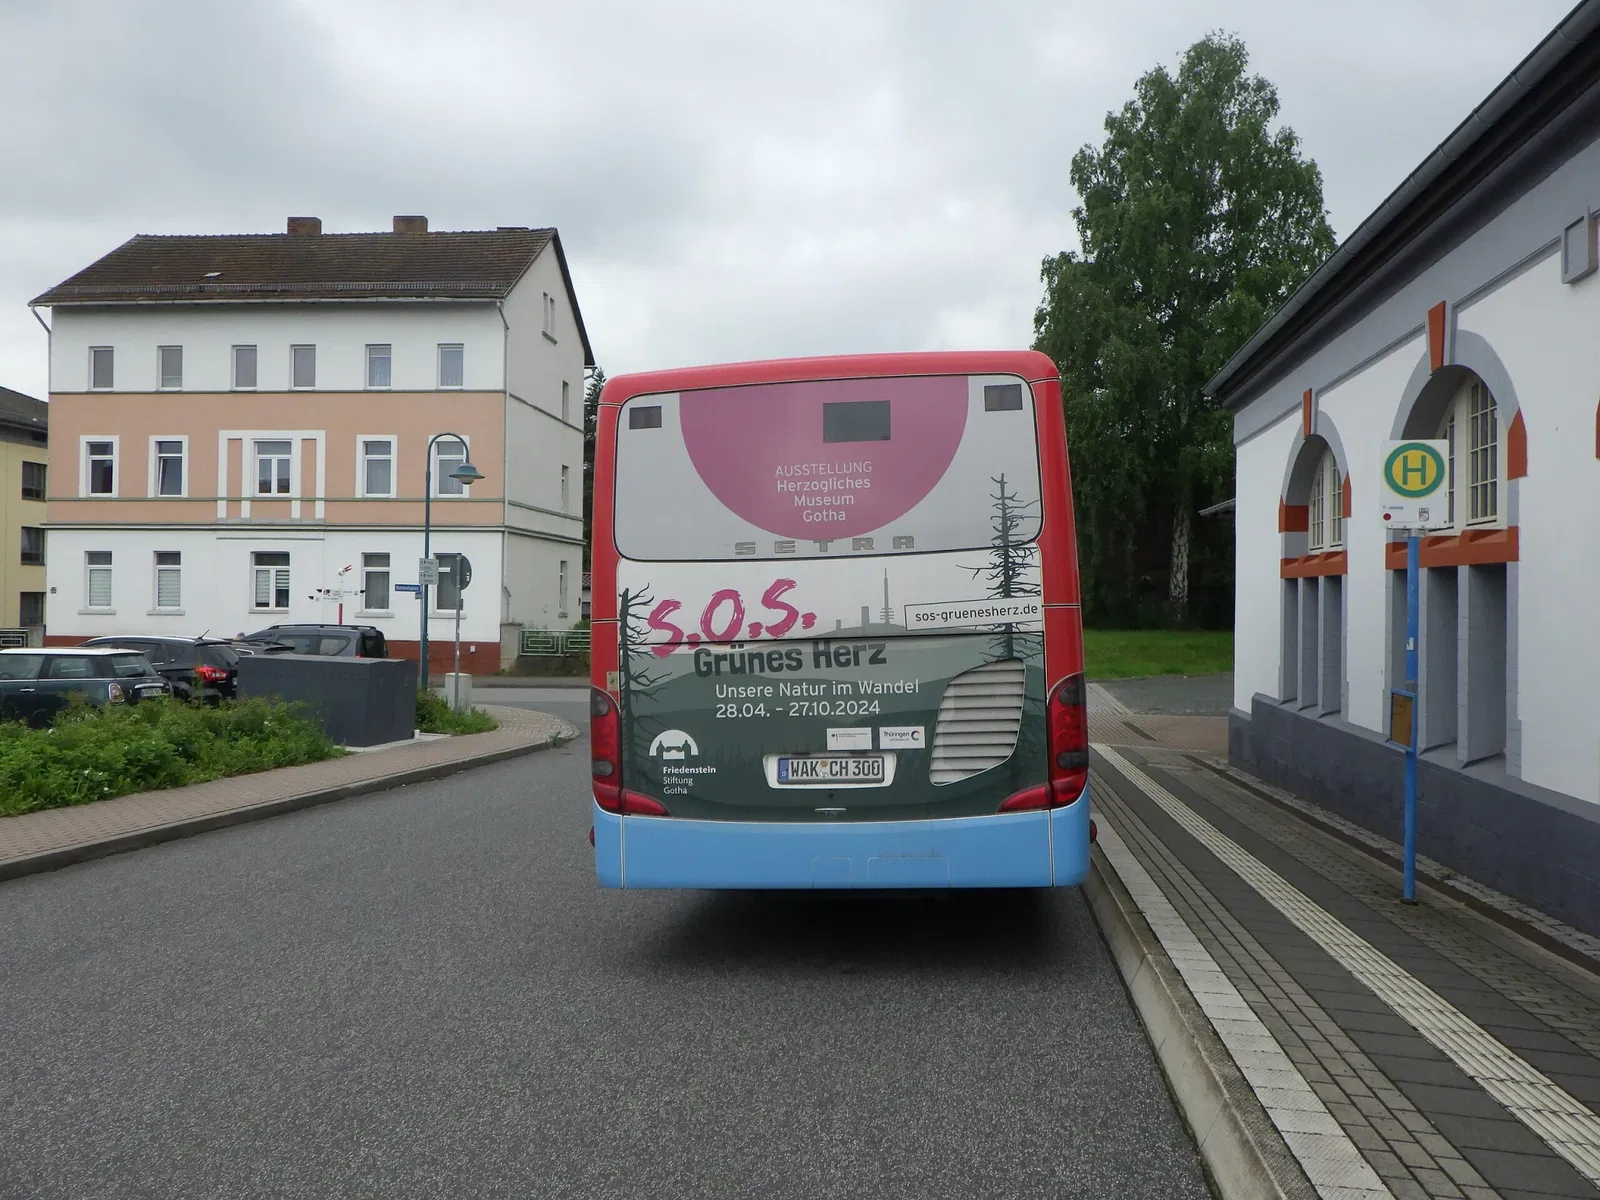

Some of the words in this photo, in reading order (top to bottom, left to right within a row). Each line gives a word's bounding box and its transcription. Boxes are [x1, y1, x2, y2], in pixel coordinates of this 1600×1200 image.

[775, 461, 873, 477] AUSSTELLUNG
[1402, 455, 1427, 486] H
[777, 477, 871, 493] Herzogliches
[794, 494, 854, 507] Museum
[802, 508, 846, 522] Gotha
[735, 535, 915, 556] SETRA
[647, 577, 818, 659] S.O.S.
[915, 603, 1039, 623] sos-gruenesherz.de
[693, 643, 803, 678] Grünes
[812, 640, 888, 670] Herz
[715, 683, 774, 699] Unsere
[779, 681, 827, 697] Natur
[832, 680, 853, 696] im
[857, 679, 920, 695] Wandel
[715, 703, 771, 719] 28.04.
[789, 699, 881, 717] 27.10.2024
[883, 731, 910, 739] Thüringen
[662, 765, 717, 775] Friedenstein
[790, 760, 819, 778] WAK
[829, 760, 849, 777] CH
[852, 760, 881, 777] 300
[662, 776, 694, 787] Stiftung
[663, 786, 688, 795] Gotha
